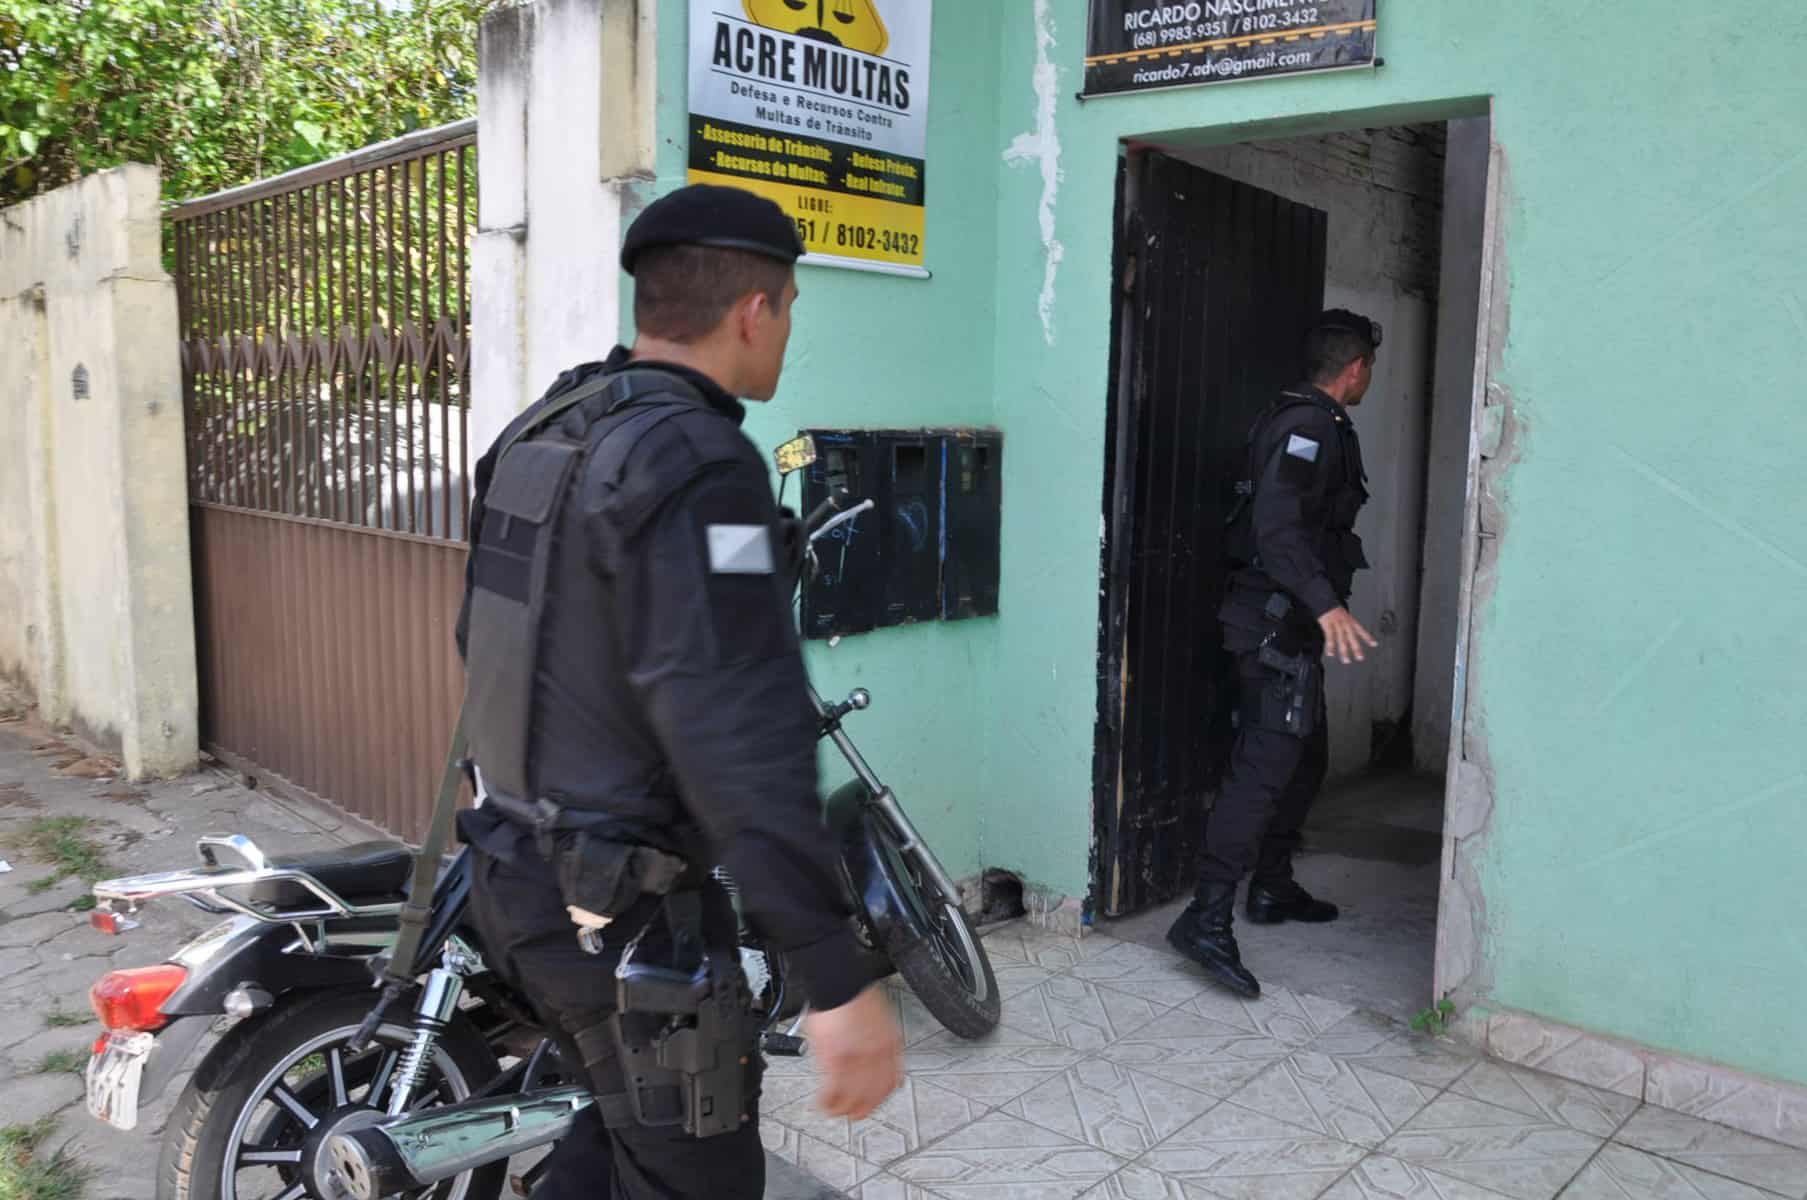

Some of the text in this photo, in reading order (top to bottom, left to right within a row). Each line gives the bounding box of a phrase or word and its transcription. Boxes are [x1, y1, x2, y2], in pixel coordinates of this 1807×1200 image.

[1124, 2, 1201, 31] RICARDO
[1133, 30, 1157, 49] (68)
[1160, 20, 1228, 43] 9983-9351
[1242, 7, 1318, 32] 8102-3432
[712, 21, 910, 110] ACRE MULTAS
[1133, 51, 1311, 84] ricardo7.adv@gmail.com
[730, 80, 893, 129] Defesa e Recursos Contra
[755, 106, 801, 127] Multas
[806, 116, 821, 131] de
[837, 223, 919, 256] 8102-3432
